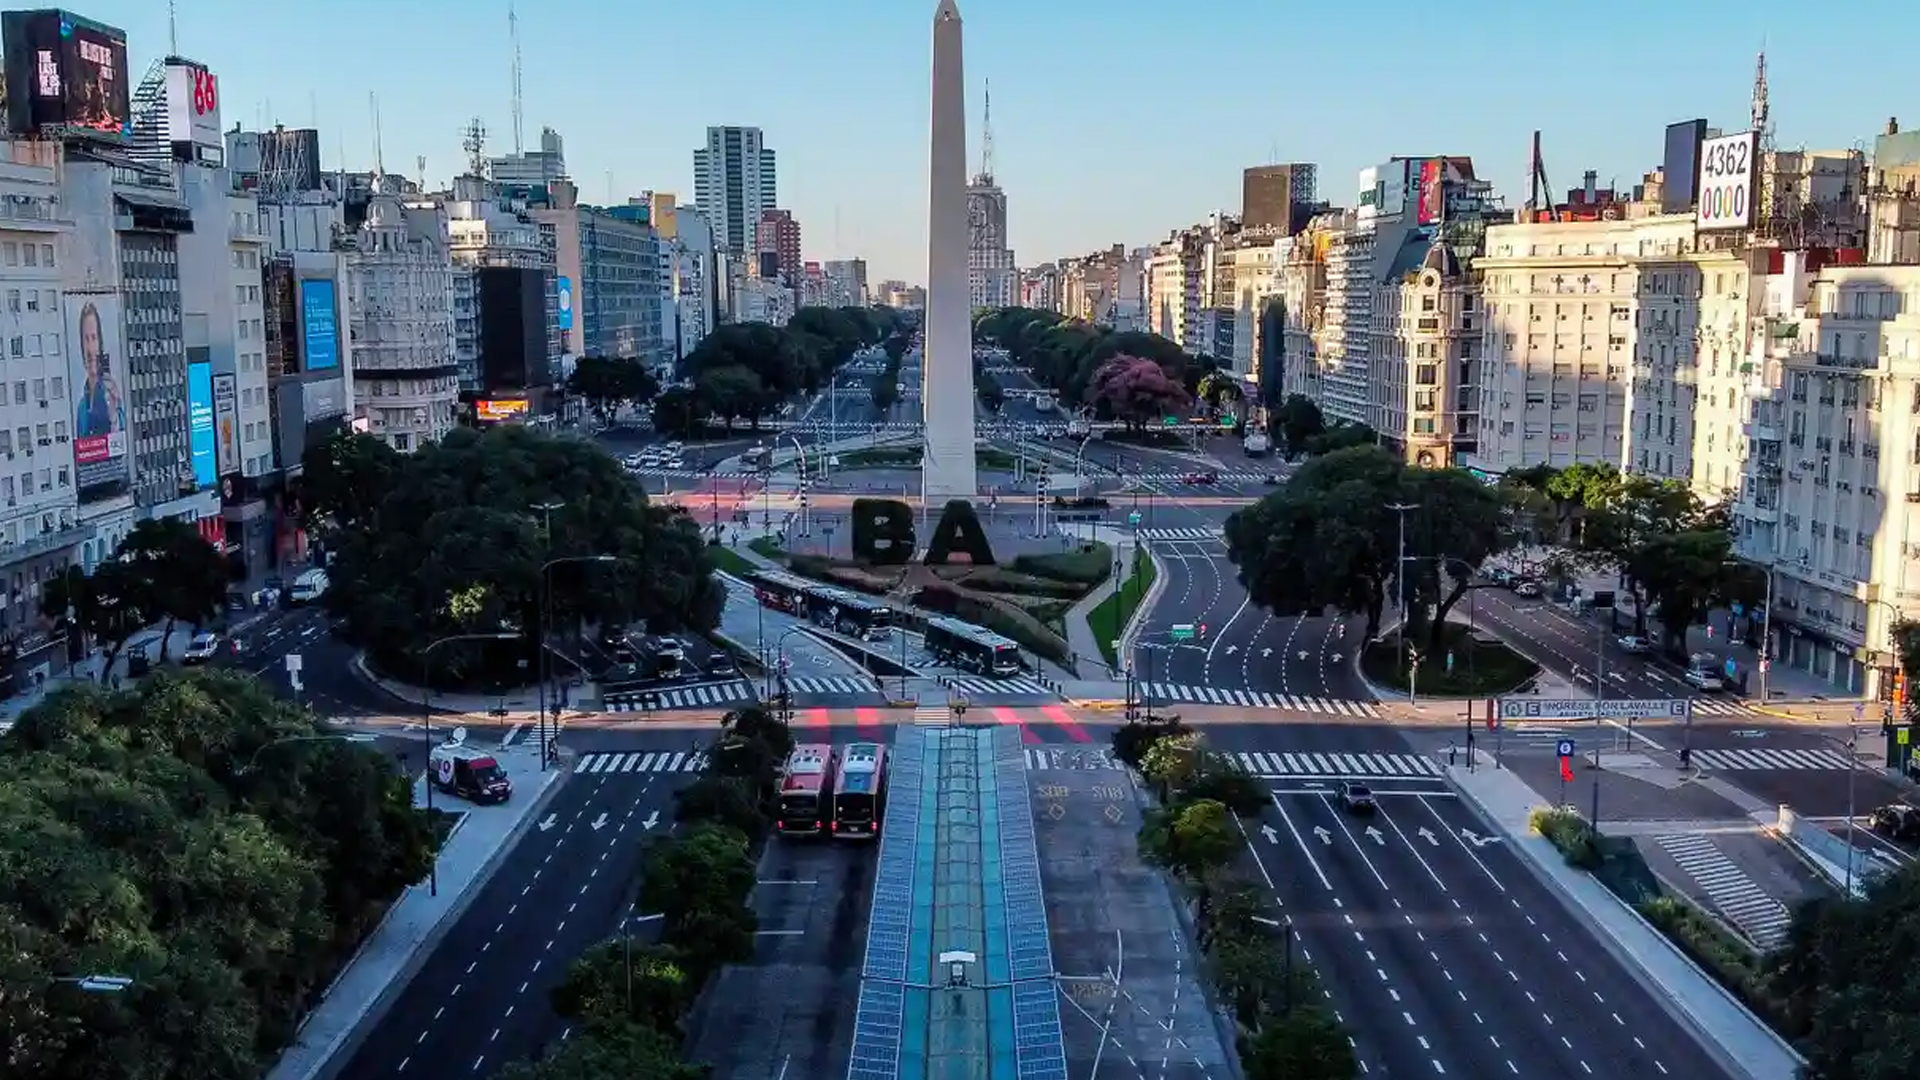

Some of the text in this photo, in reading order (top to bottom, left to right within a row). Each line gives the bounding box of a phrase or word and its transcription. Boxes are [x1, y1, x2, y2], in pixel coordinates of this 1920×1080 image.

[1705, 141, 1747, 177] 4362
[1703, 184, 1744, 219] 0000
[852, 498, 997, 565] BA
